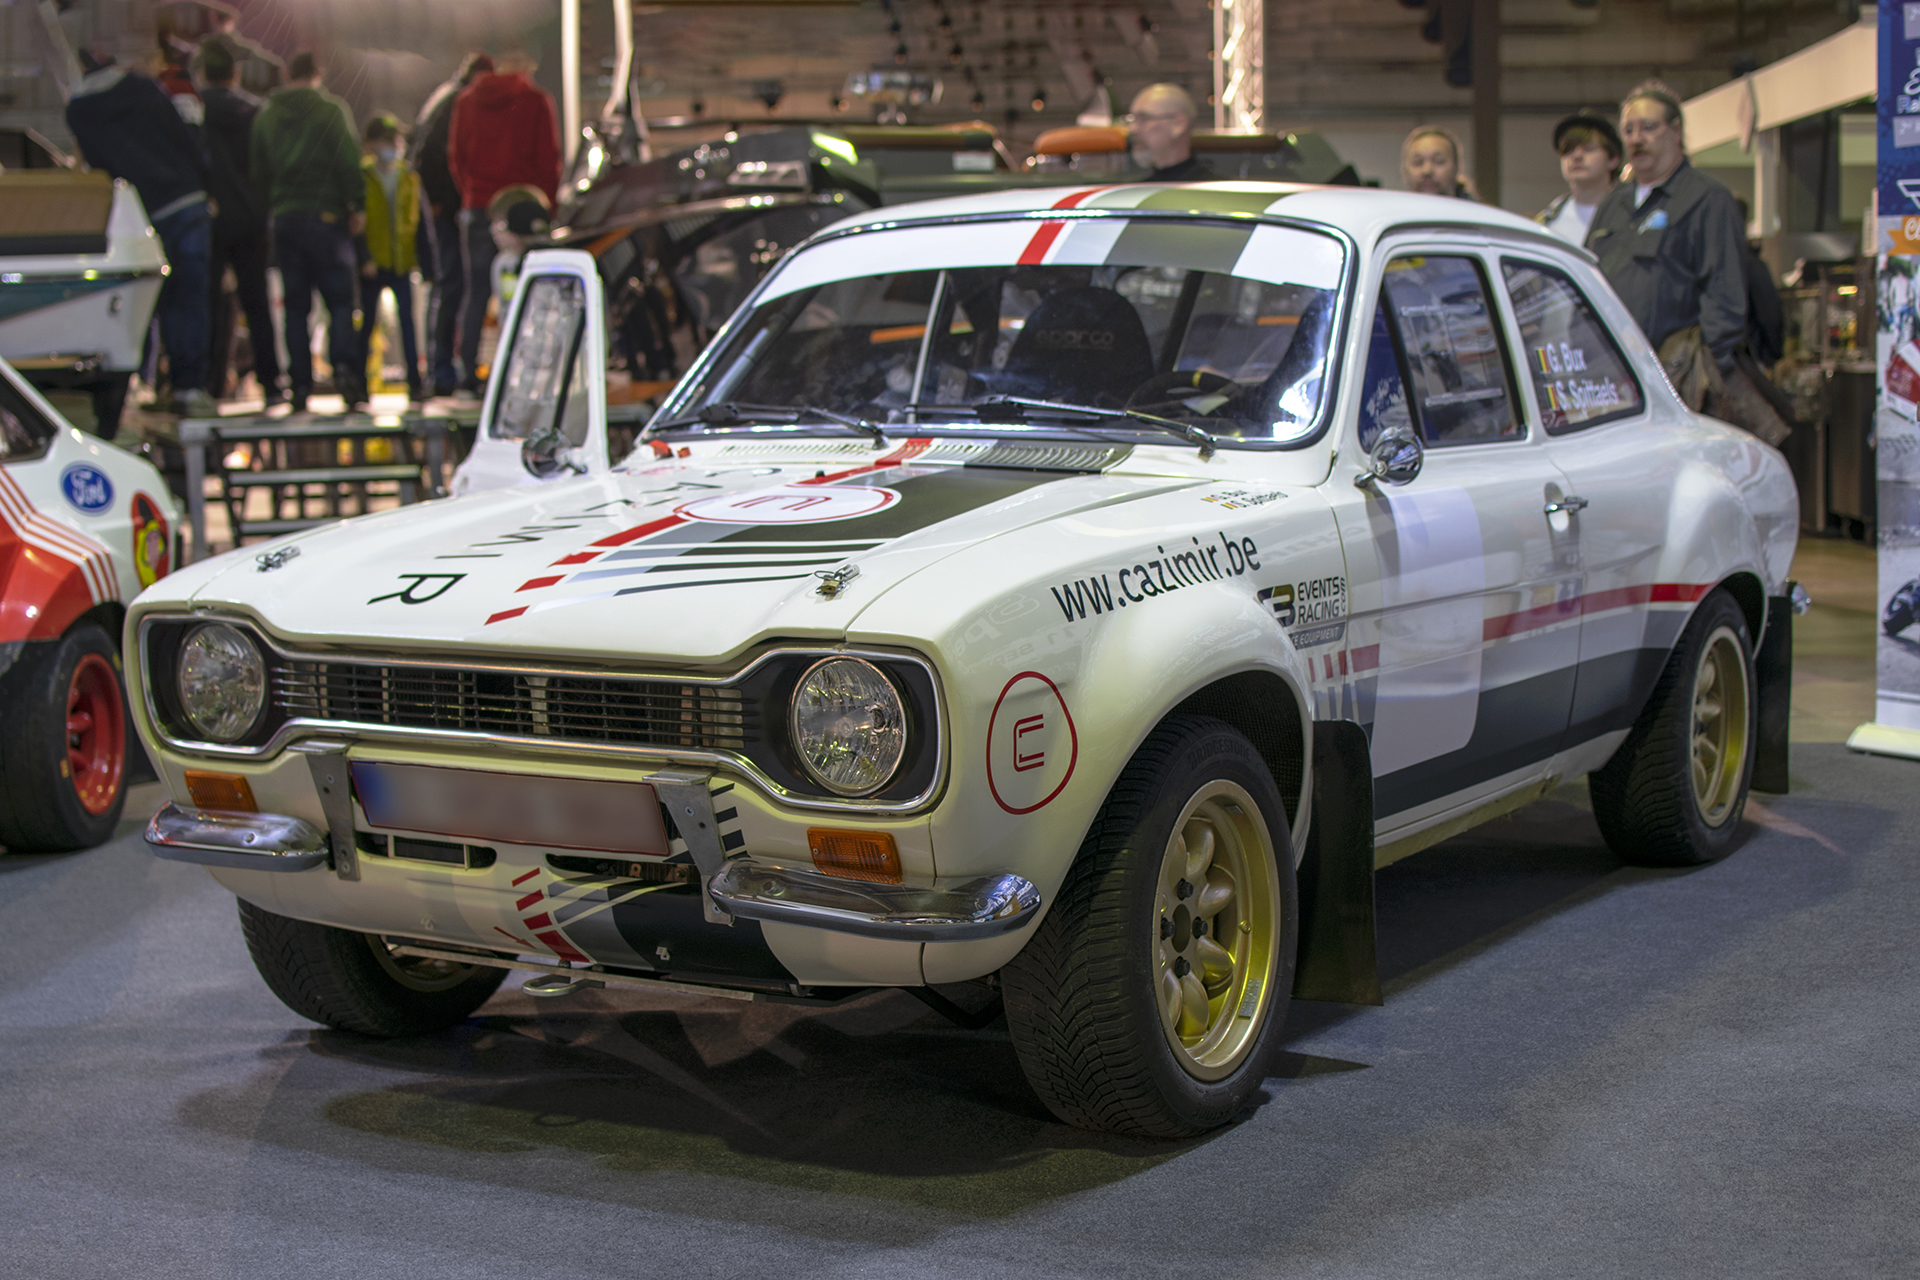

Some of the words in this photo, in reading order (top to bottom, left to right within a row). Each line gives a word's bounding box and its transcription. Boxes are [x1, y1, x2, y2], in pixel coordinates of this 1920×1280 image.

[1546, 342, 1563, 373] G.
[1560, 342, 1588, 372] Bux
[1555, 379, 1571, 411] S.
[1297, 576, 1340, 602] EVENTS
[1297, 598, 1340, 625] RACING
[1299, 626, 1340, 645] EQUIPMENT
[1187, 738, 1252, 771] BRIDGESTONE
